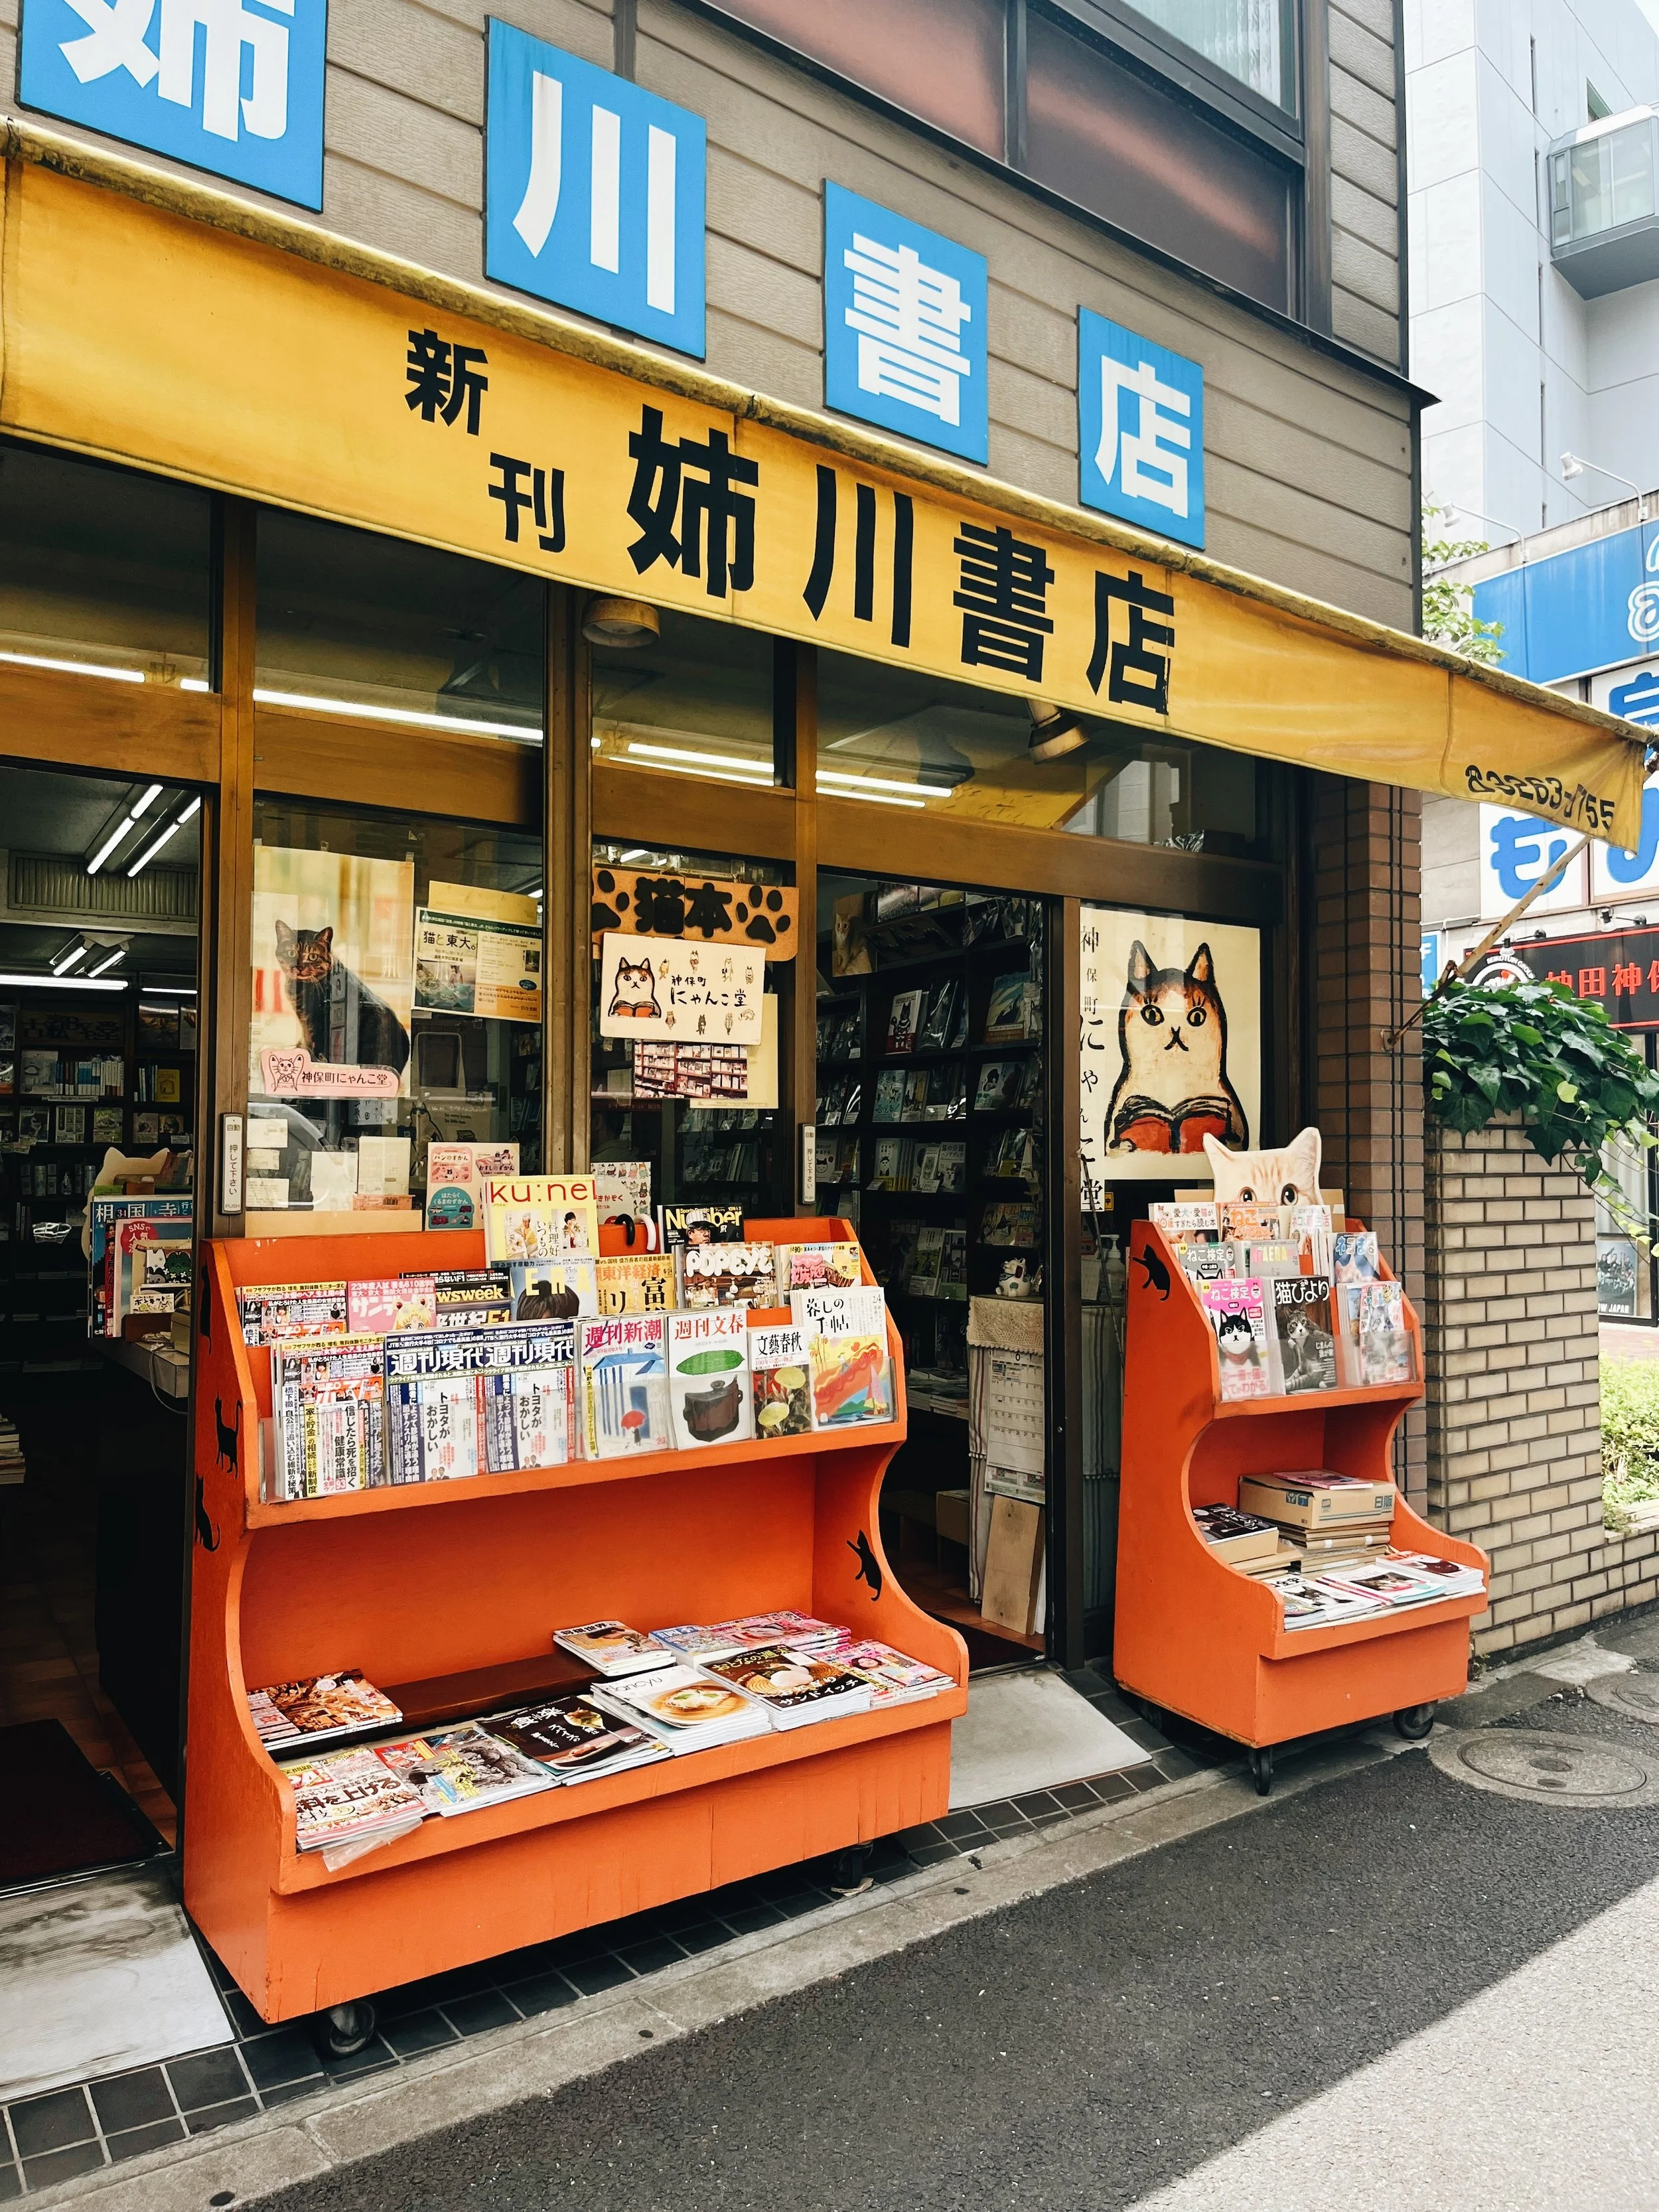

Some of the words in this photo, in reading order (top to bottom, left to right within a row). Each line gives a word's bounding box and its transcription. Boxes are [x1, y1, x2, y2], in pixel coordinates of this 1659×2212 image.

[404, 329, 567, 553] 新刊
[626, 404, 1175, 716] 姉川書店
[634, 877, 733, 938] 猫本
[423, 930, 476, 951] 猫と東大。
[671, 975, 707, 987] 神保町
[670, 988, 748, 1007] にゃんこ堂
[301, 1071, 388, 1087] 神保町にゃんこ堂
[229, 1144, 238, 1195] 押して下さい
[490, 1179, 597, 1203] ku:nel
[665, 1207, 743, 1230] Nuber
[1229, 1209, 1259, 1228] ねこ
[685, 1247, 773, 1278] POPEYE
[1187, 1248, 1226, 1264] ねこ検定
[510, 1266, 591, 1298] ERA
[602, 1263, 661, 1281] 東洋経済
[435, 1284, 504, 1303] wsweek
[1210, 1286, 1252, 1301] ねこ検定
[1275, 1278, 1330, 1305] 猫びより
[585, 1318, 662, 1349] 週刊新潮
[674, 1313, 744, 1341] 週刊文春
[484, 1339, 574, 1368] 週刊現代
[756, 1331, 802, 1357] 文藝春秋
[390, 1346, 484, 1376] 週刊現代
[439, 1392, 451, 1439] トヨタが
[519, 1396, 531, 1441] おかしい
[531, 1383, 542, 1428] トヨタが
[426, 1405, 439, 1452] おかしい
[334, 1435, 346, 1479] 健康常識
[344, 1405, 357, 1488] 信じたら死を招く
[307, 1470, 317, 1494] 新制度
[605, 1676, 664, 1691] dancyu
[778, 1678, 860, 1706] サンドイッチ
